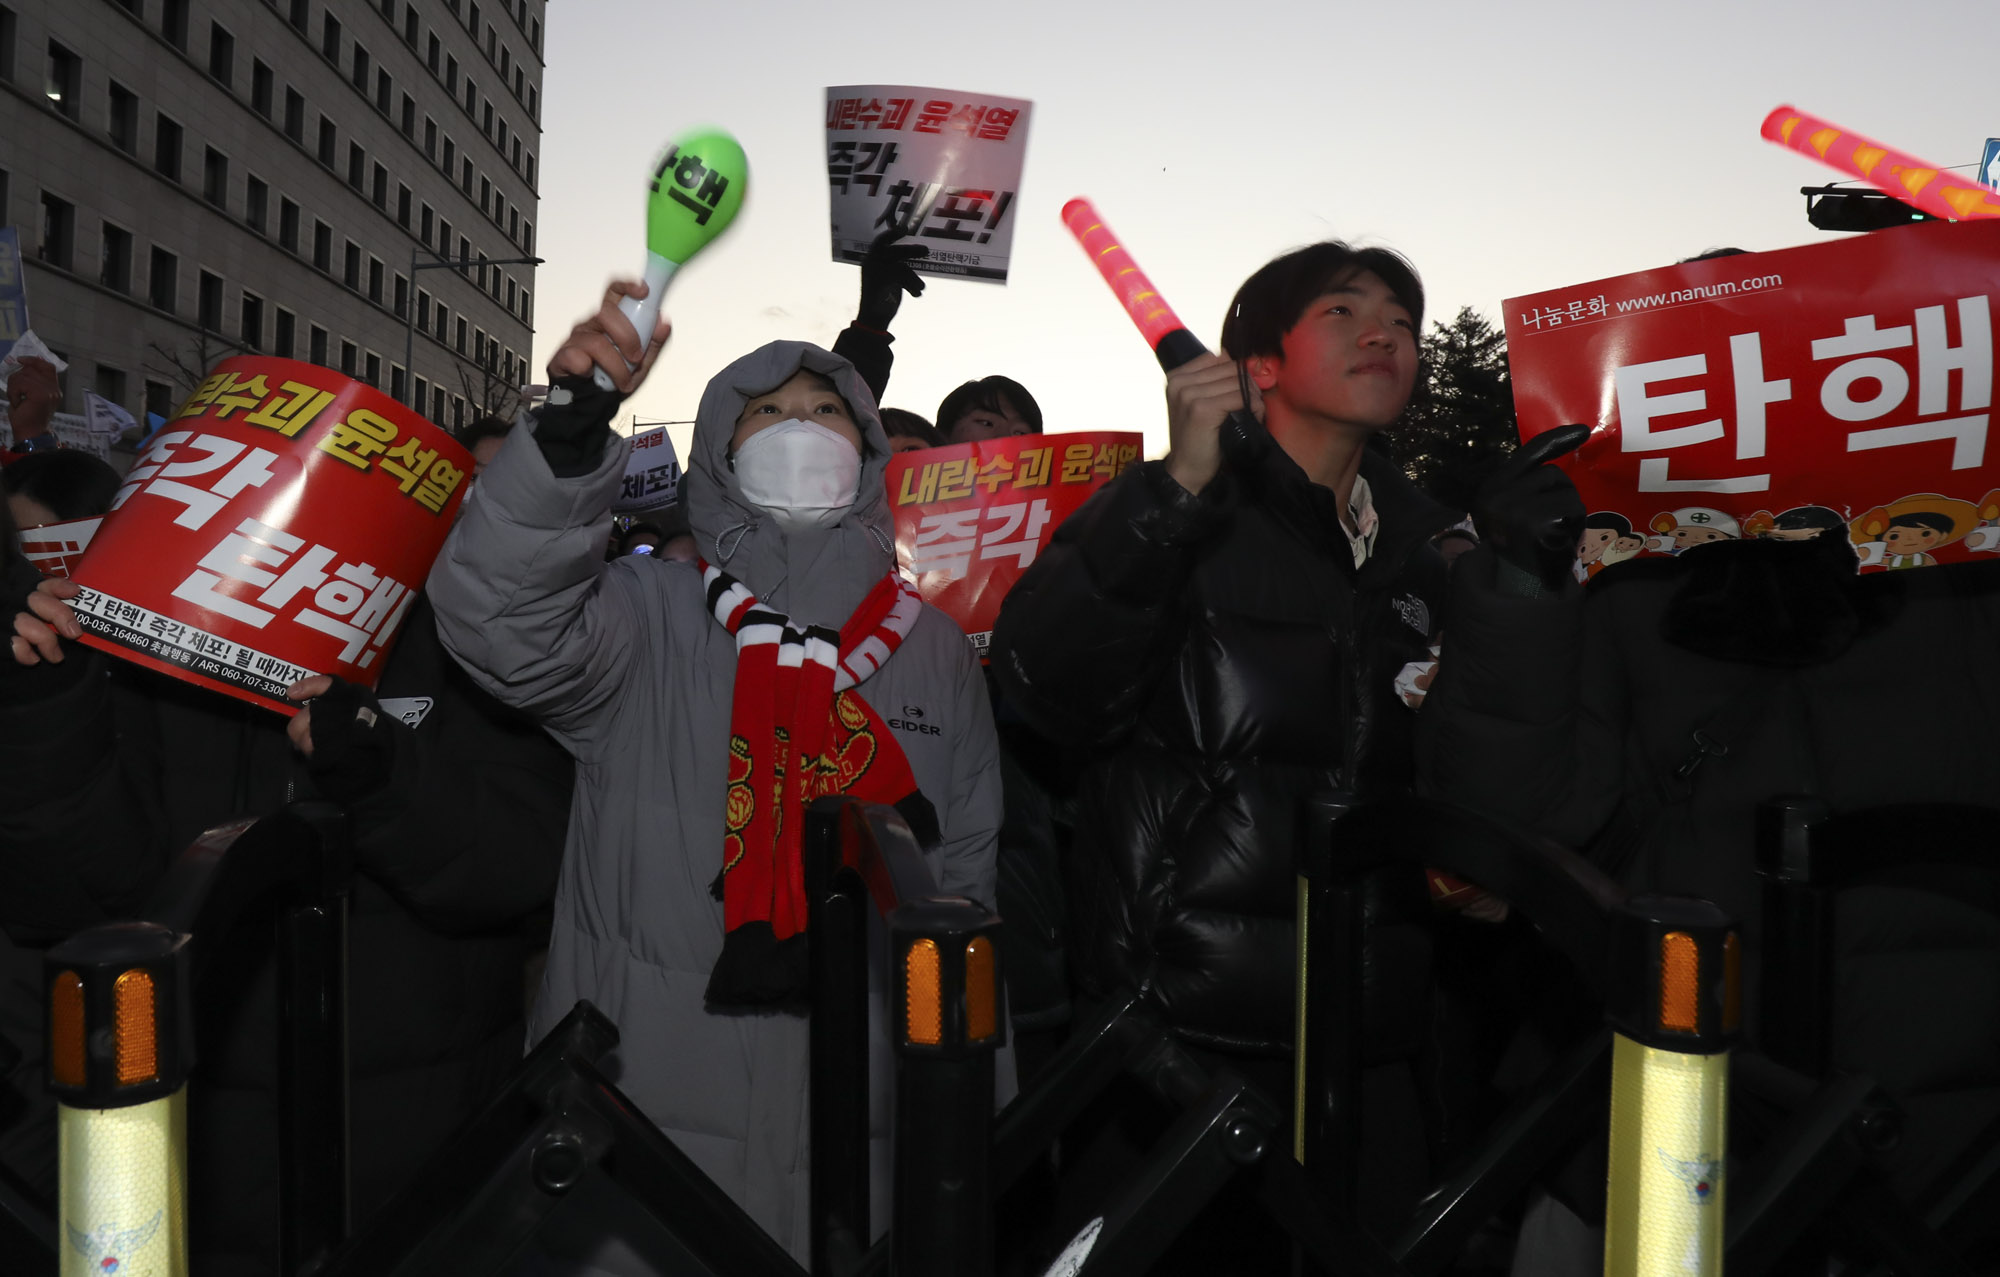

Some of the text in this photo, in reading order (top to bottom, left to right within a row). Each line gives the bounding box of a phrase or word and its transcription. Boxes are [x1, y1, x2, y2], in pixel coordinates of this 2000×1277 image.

[826, 98, 1020, 141] 내란수괴 윤석열
[828, 141, 898, 197] 즉각
[1521, 273, 1783, 330] 나눔문화 www.nanum.com
[1614, 294, 1994, 495] 탄핵
[316, 408, 465, 513] 윤석열
[621, 461, 677, 500] 체포!
[897, 446, 1054, 506] 내란수괴
[914, 498, 1052, 581] 즉각
[170, 517, 416, 669] 탄핵!
[103, 599, 147, 628] 탄핵!
[149, 616, 187, 644] 즉각
[187, 631, 232, 660] 체포!
[234, 648, 255, 669] 될
[150, 640, 192, 664] 촛불행동
[198, 659, 220, 674] ARS
[220, 666, 287, 697] 060-707-3300
[888, 718, 941, 737] EIDER
